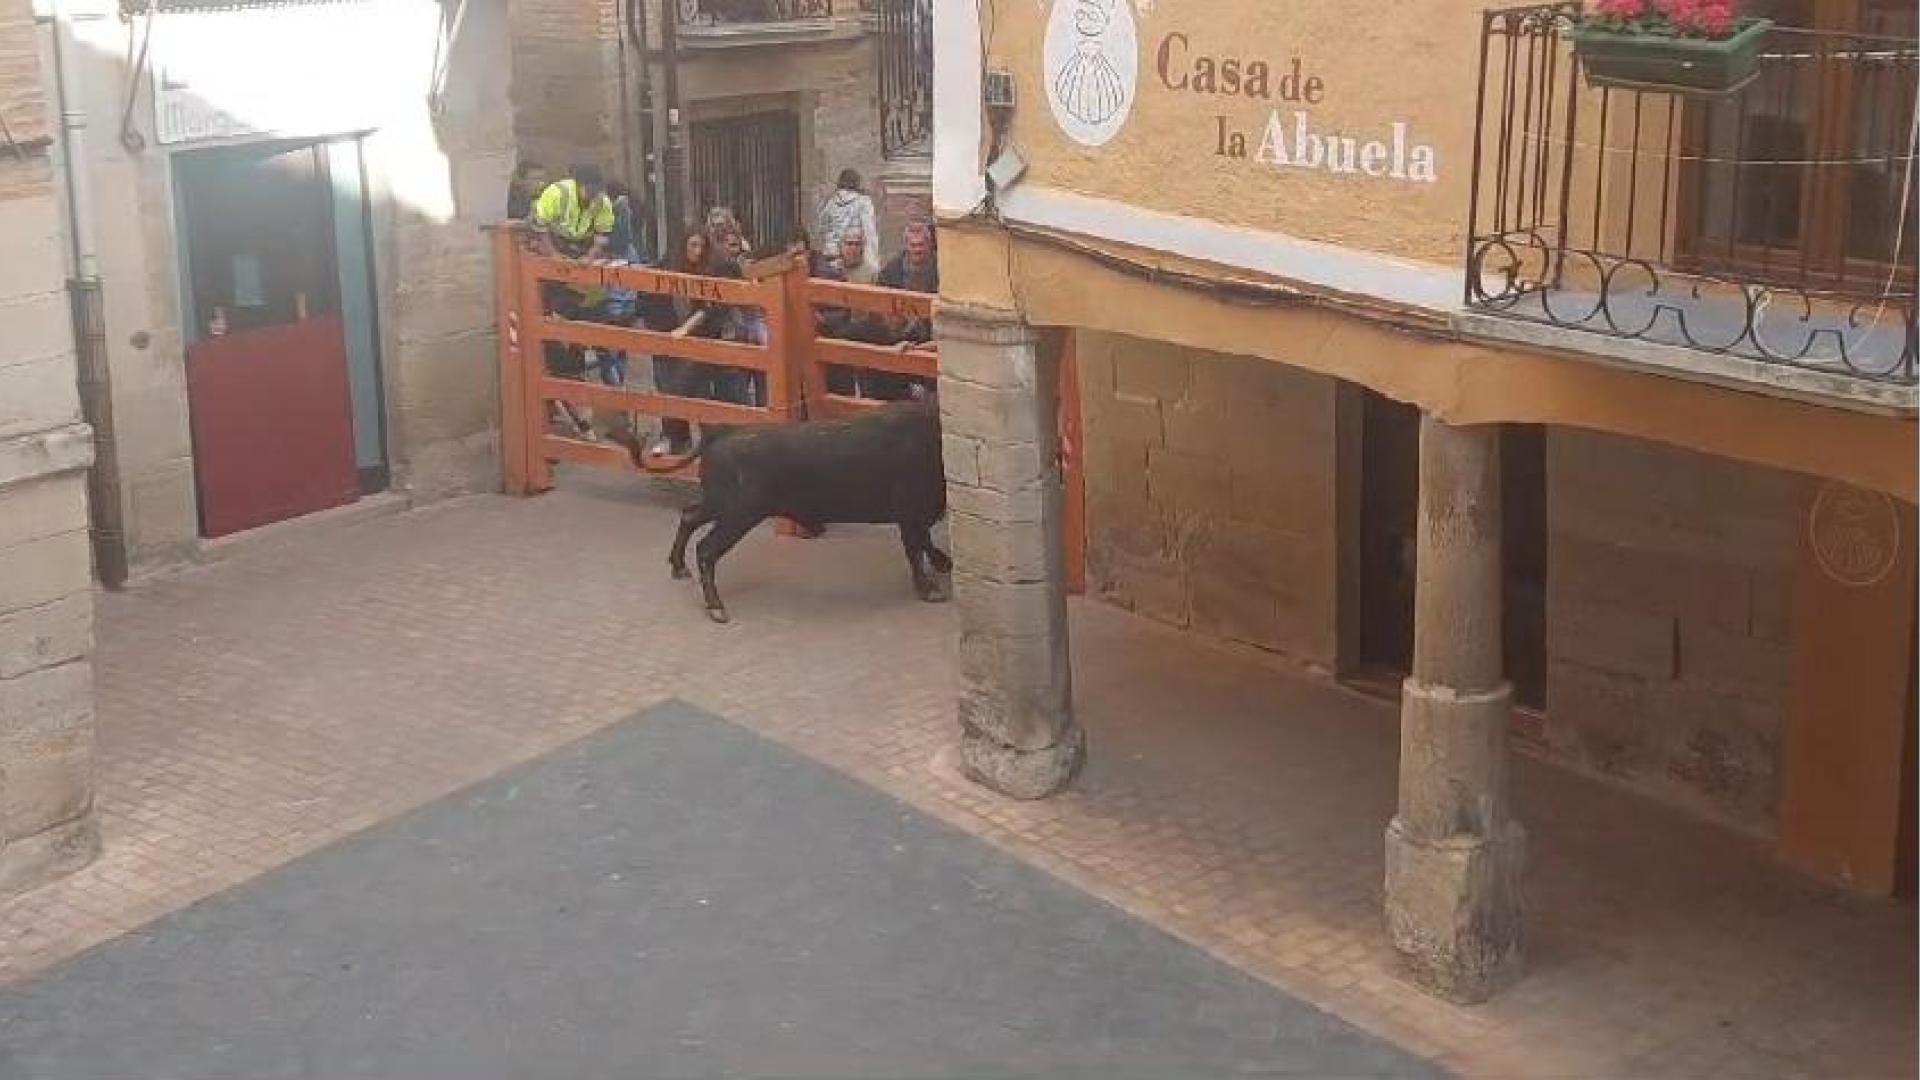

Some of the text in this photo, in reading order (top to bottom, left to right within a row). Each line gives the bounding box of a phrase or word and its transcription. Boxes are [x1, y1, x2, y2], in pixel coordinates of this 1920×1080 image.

[1157, 31, 1325, 104] Casa de
[1214, 108, 1437, 183] la Abuela
